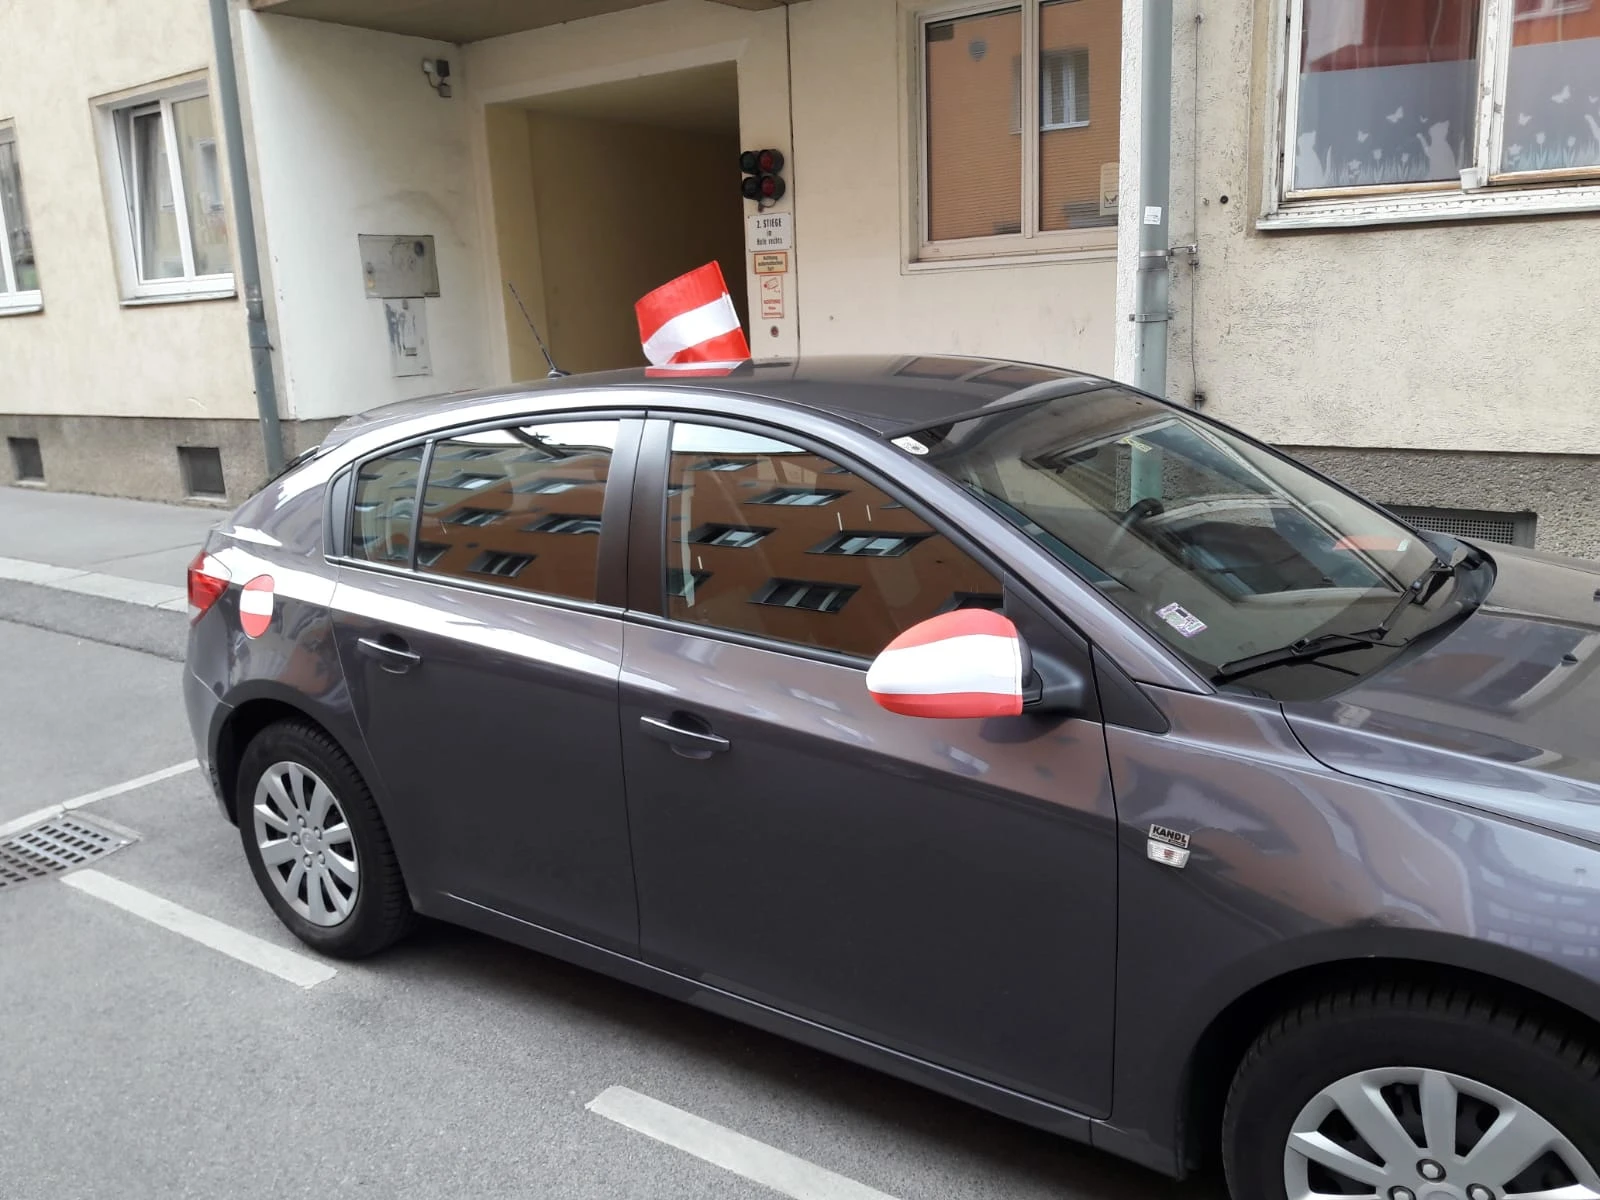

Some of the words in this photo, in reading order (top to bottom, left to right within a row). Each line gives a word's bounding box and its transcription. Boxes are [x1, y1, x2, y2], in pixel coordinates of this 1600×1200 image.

[756, 220, 761, 228] 2.
[763, 218, 782, 228] STIEGE
[1152, 826, 1187, 843] KANDL
